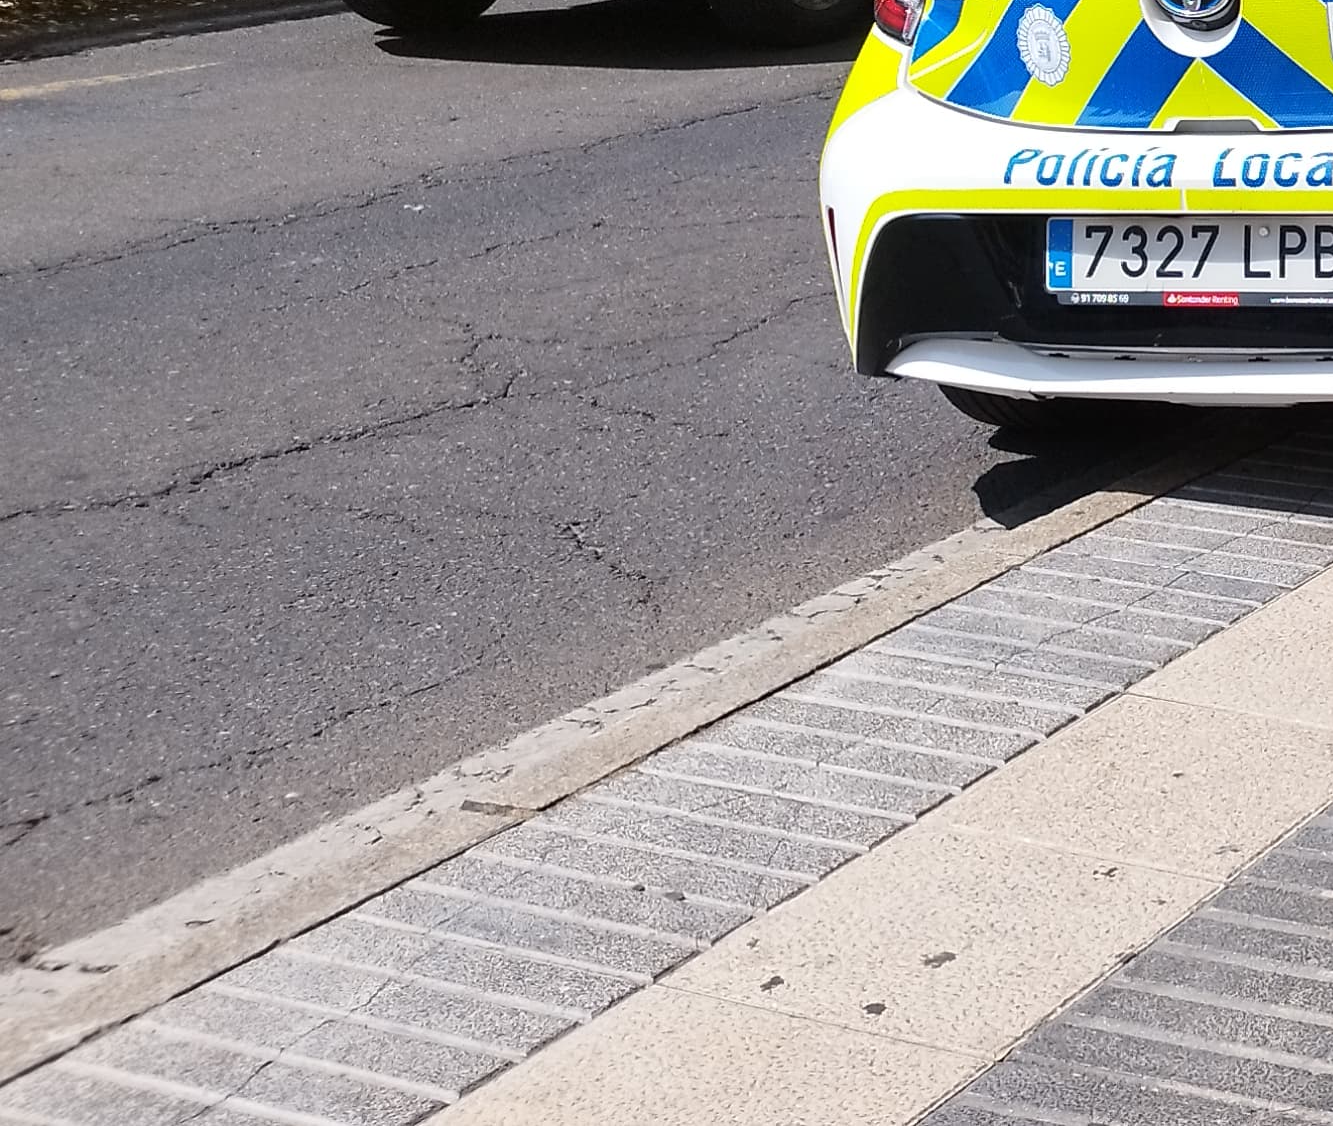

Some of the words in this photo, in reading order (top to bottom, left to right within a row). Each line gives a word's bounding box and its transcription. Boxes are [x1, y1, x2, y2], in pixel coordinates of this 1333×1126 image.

[1003, 146, 1178, 188] Policía
[1055, 263, 1067, 276] E
[1084, 225, 1220, 279] 7327
[1176, 294, 1211, 305] Santander
[1212, 295, 1239, 306] Renting
